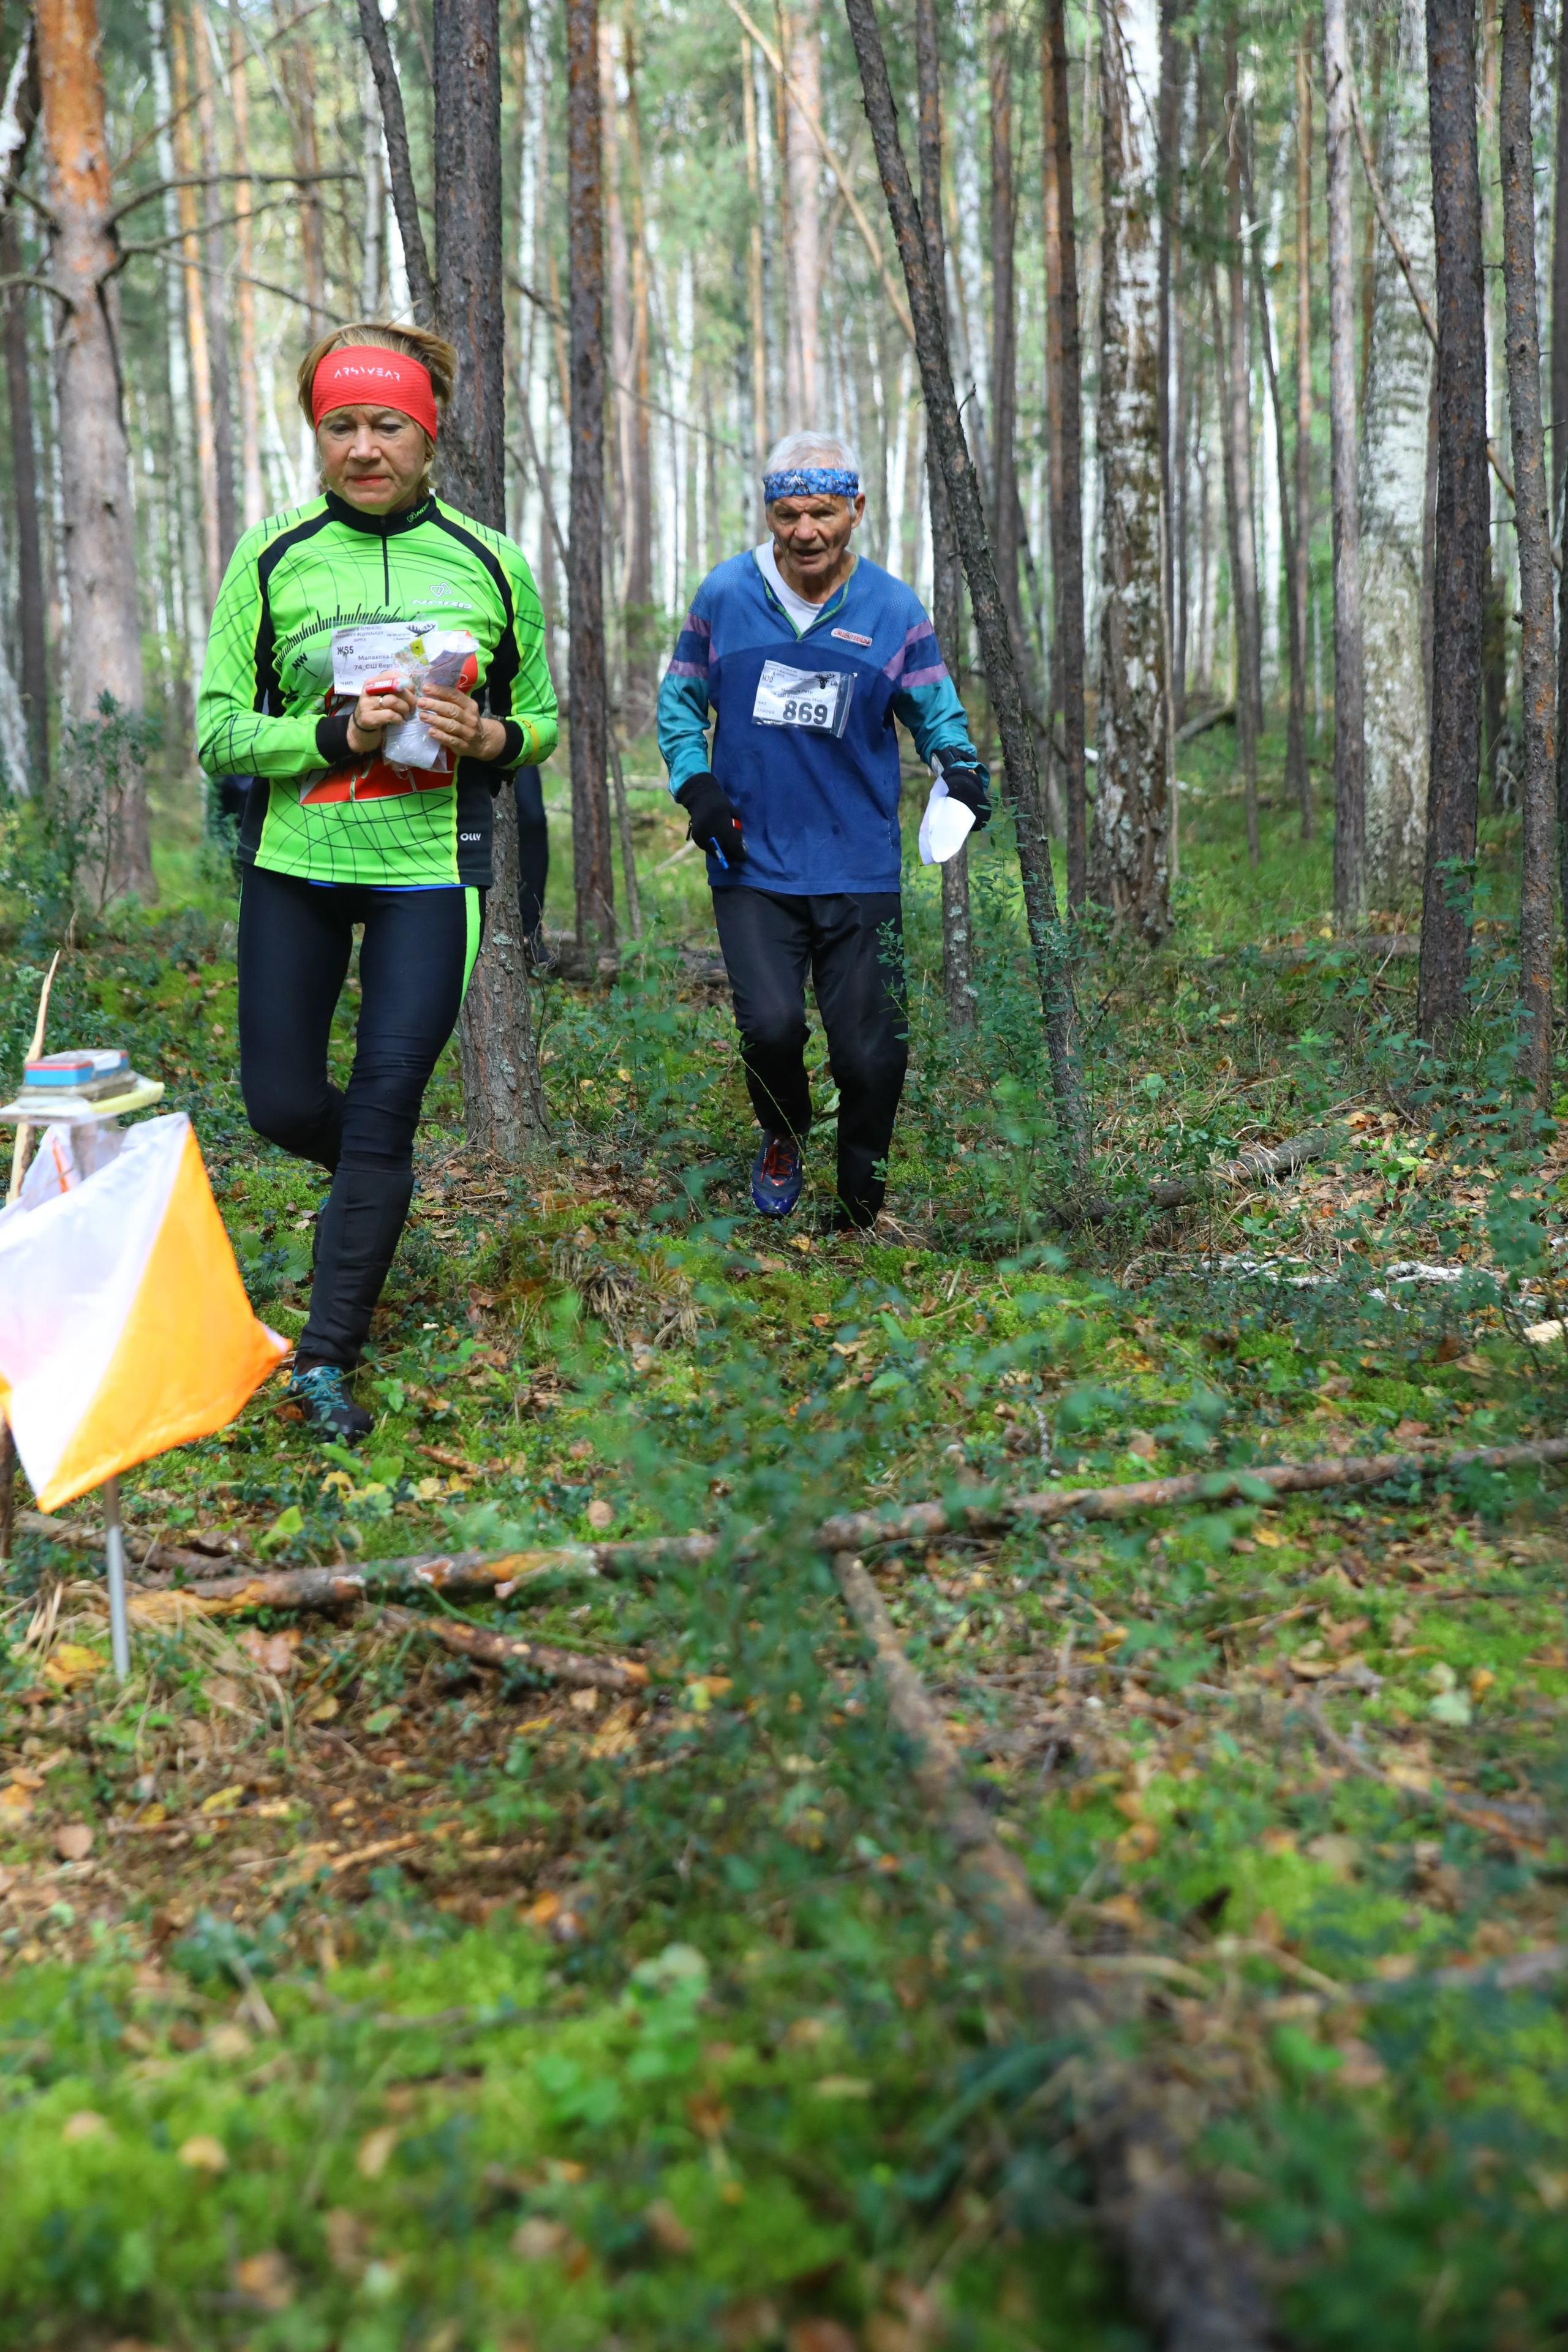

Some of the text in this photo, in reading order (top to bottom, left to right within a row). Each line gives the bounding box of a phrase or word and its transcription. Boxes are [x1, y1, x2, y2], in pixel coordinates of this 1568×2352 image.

[411, 599, 473, 610] NORD
[291, 652, 308, 671] NW
[783, 699, 827, 725] 869
